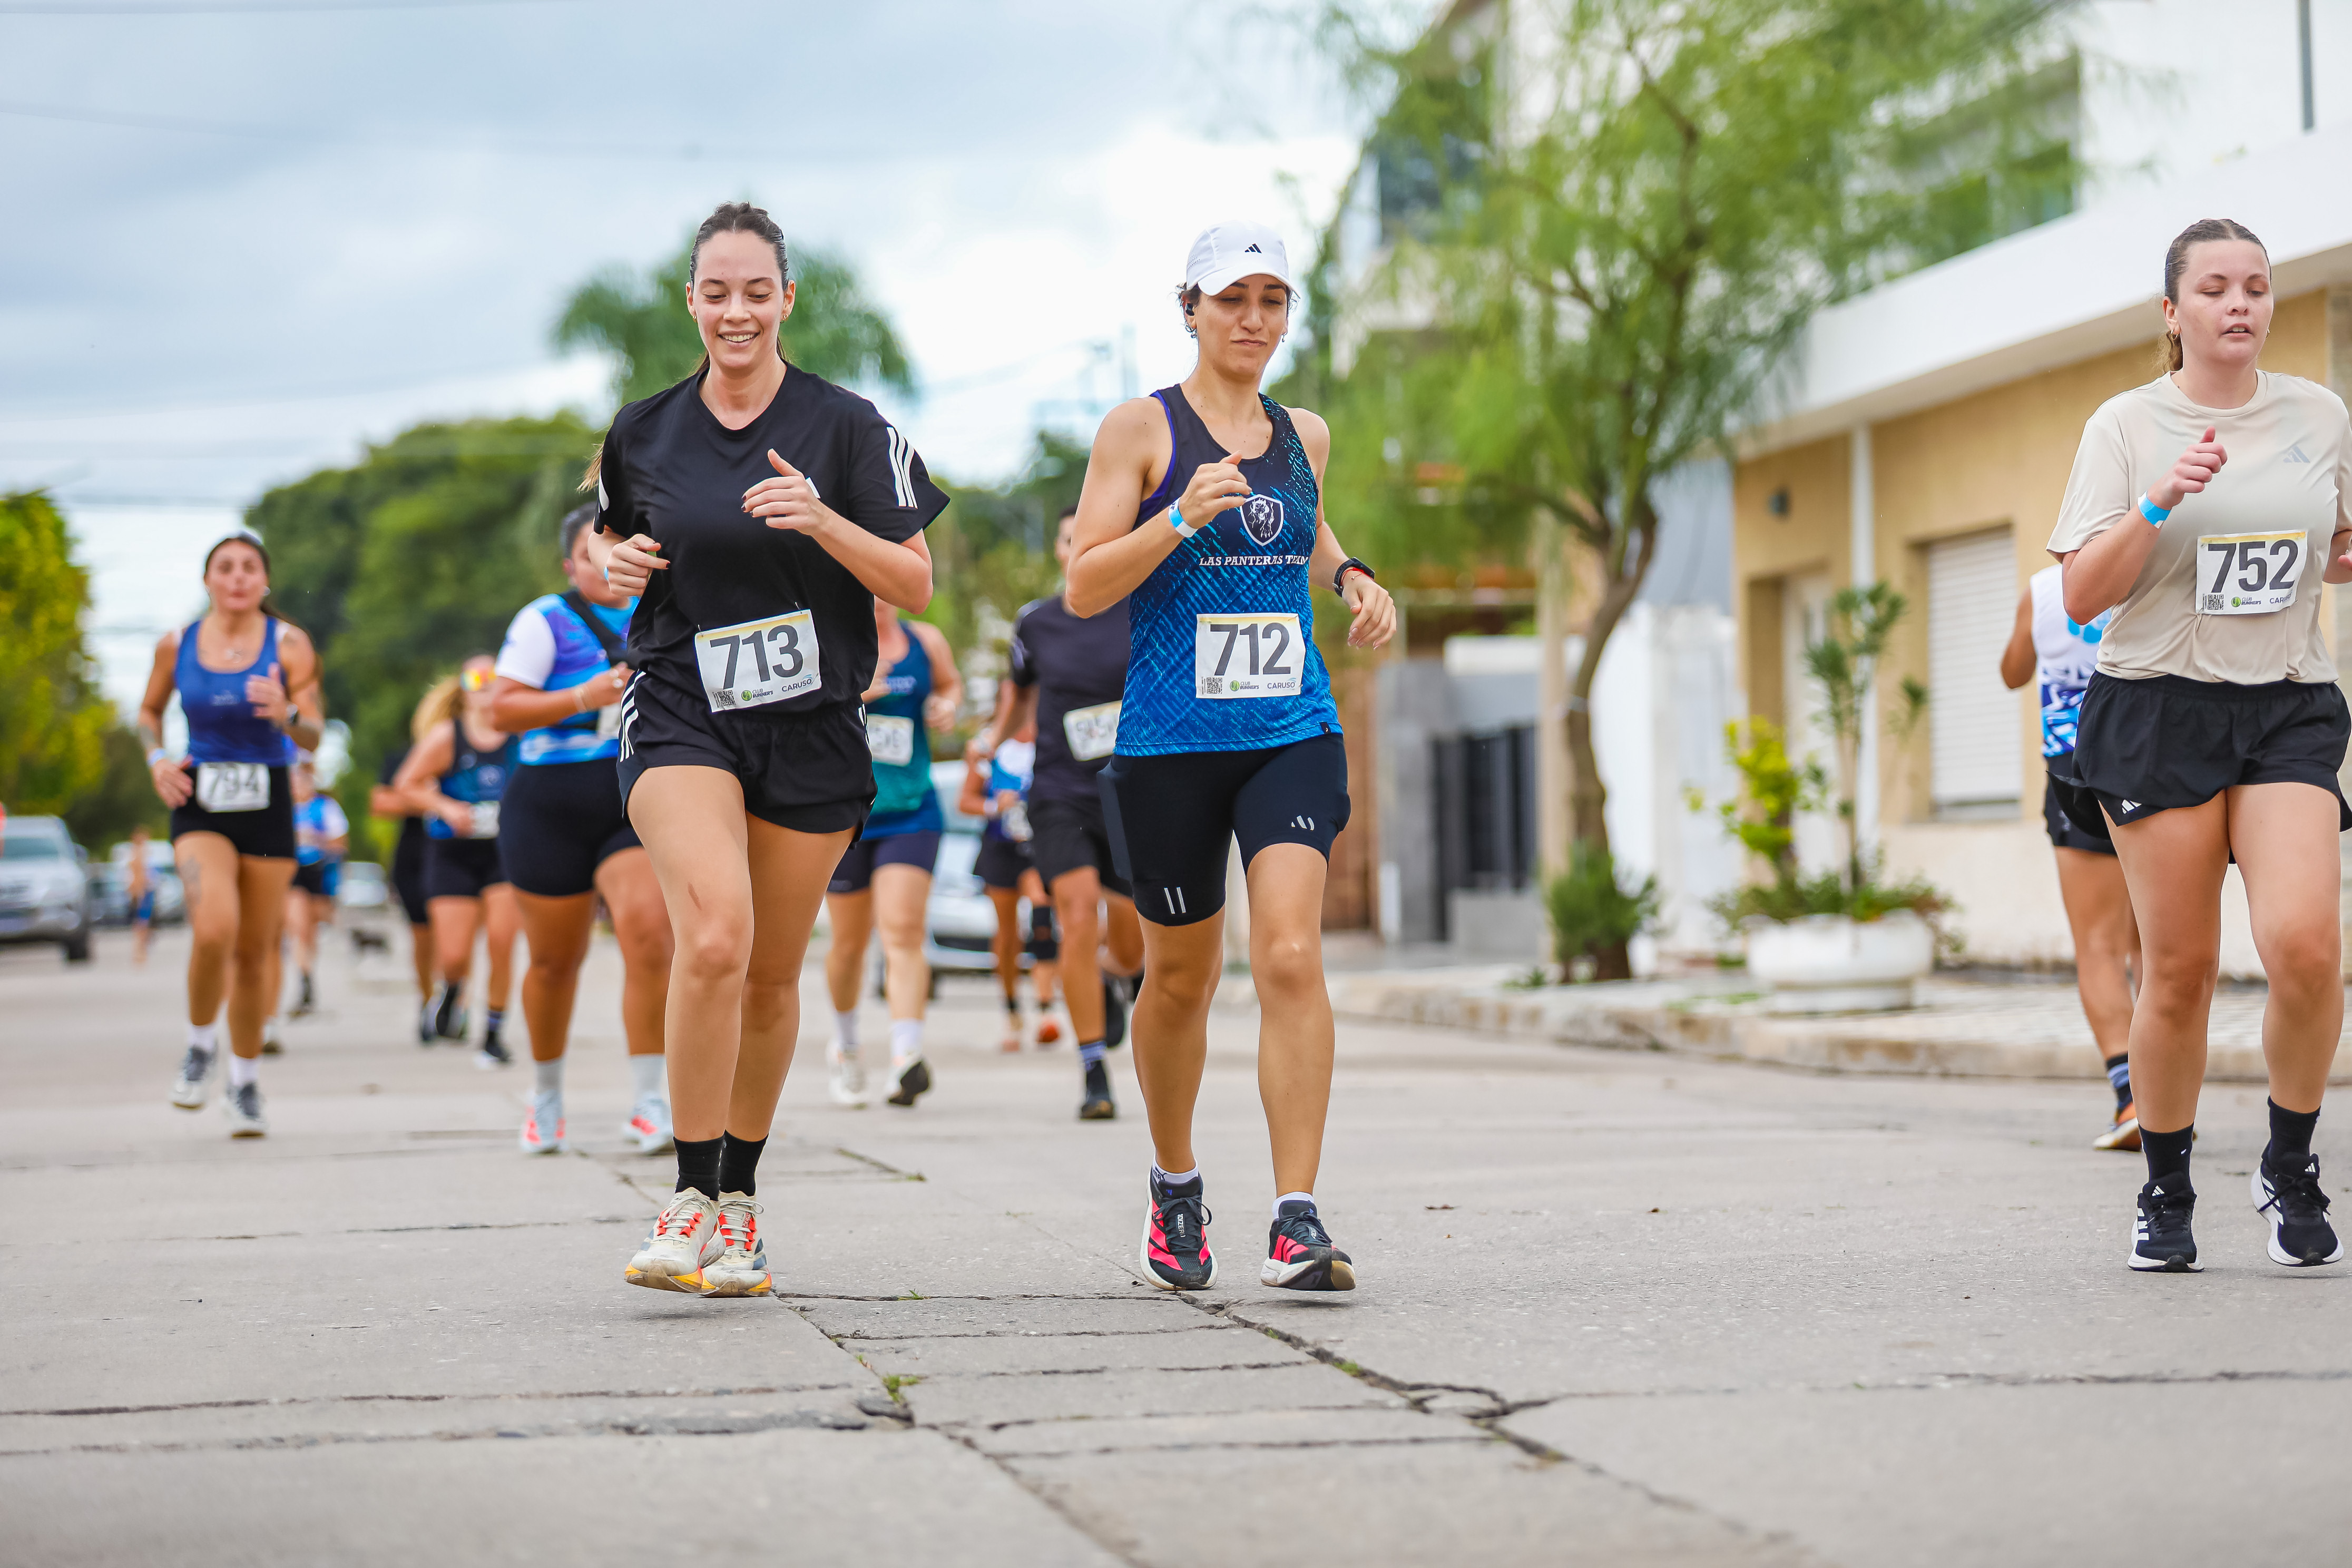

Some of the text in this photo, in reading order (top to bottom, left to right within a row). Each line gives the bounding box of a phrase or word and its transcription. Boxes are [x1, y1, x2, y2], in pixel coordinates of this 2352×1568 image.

[1199, 556, 1222, 566] LAS
[1223, 555, 1283, 566] PANTERAS
[2208, 539, 2298, 593] 752
[709, 624, 803, 690] 713
[1210, 622, 1291, 676] 712
[752, 690, 773, 699] RUNNER'S
[781, 678, 812, 692] CARUSO
[207, 763, 259, 799] 794
